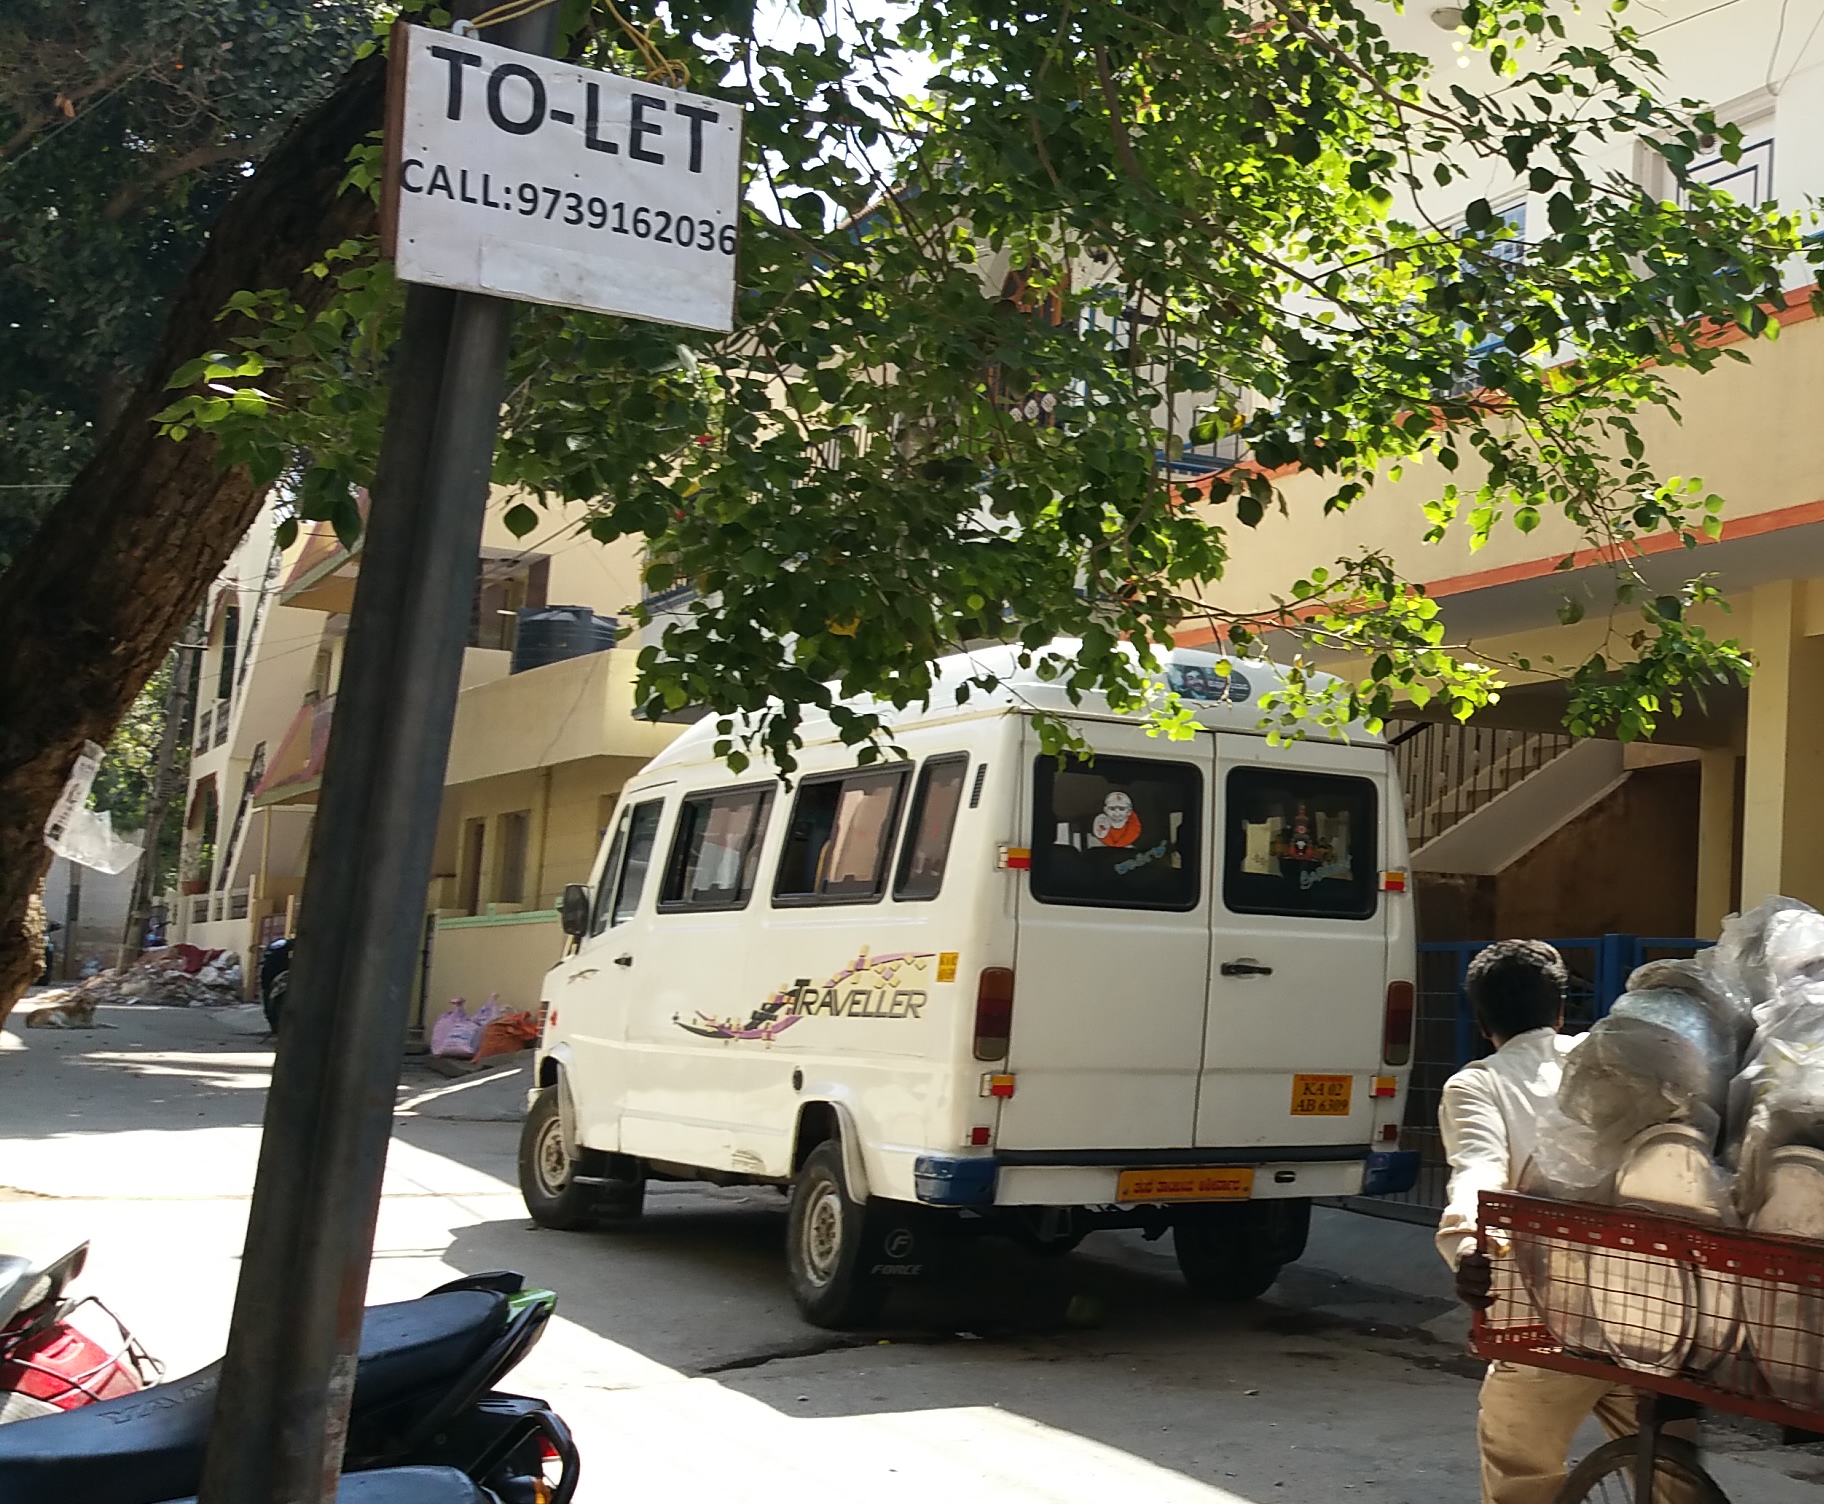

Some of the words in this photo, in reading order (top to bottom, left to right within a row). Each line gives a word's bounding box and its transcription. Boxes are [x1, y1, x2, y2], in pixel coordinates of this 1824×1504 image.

[431, 45, 719, 174] TO-LET
[400, 158, 736, 256] CALL:9739162036
[791, 979, 927, 1018] TRAVELLER
[1303, 1083, 1325, 1096] KA
[1328, 1083, 1344, 1096] 02
[1294, 1099, 1316, 1112] AB
[871, 1264, 923, 1275] FORCE
